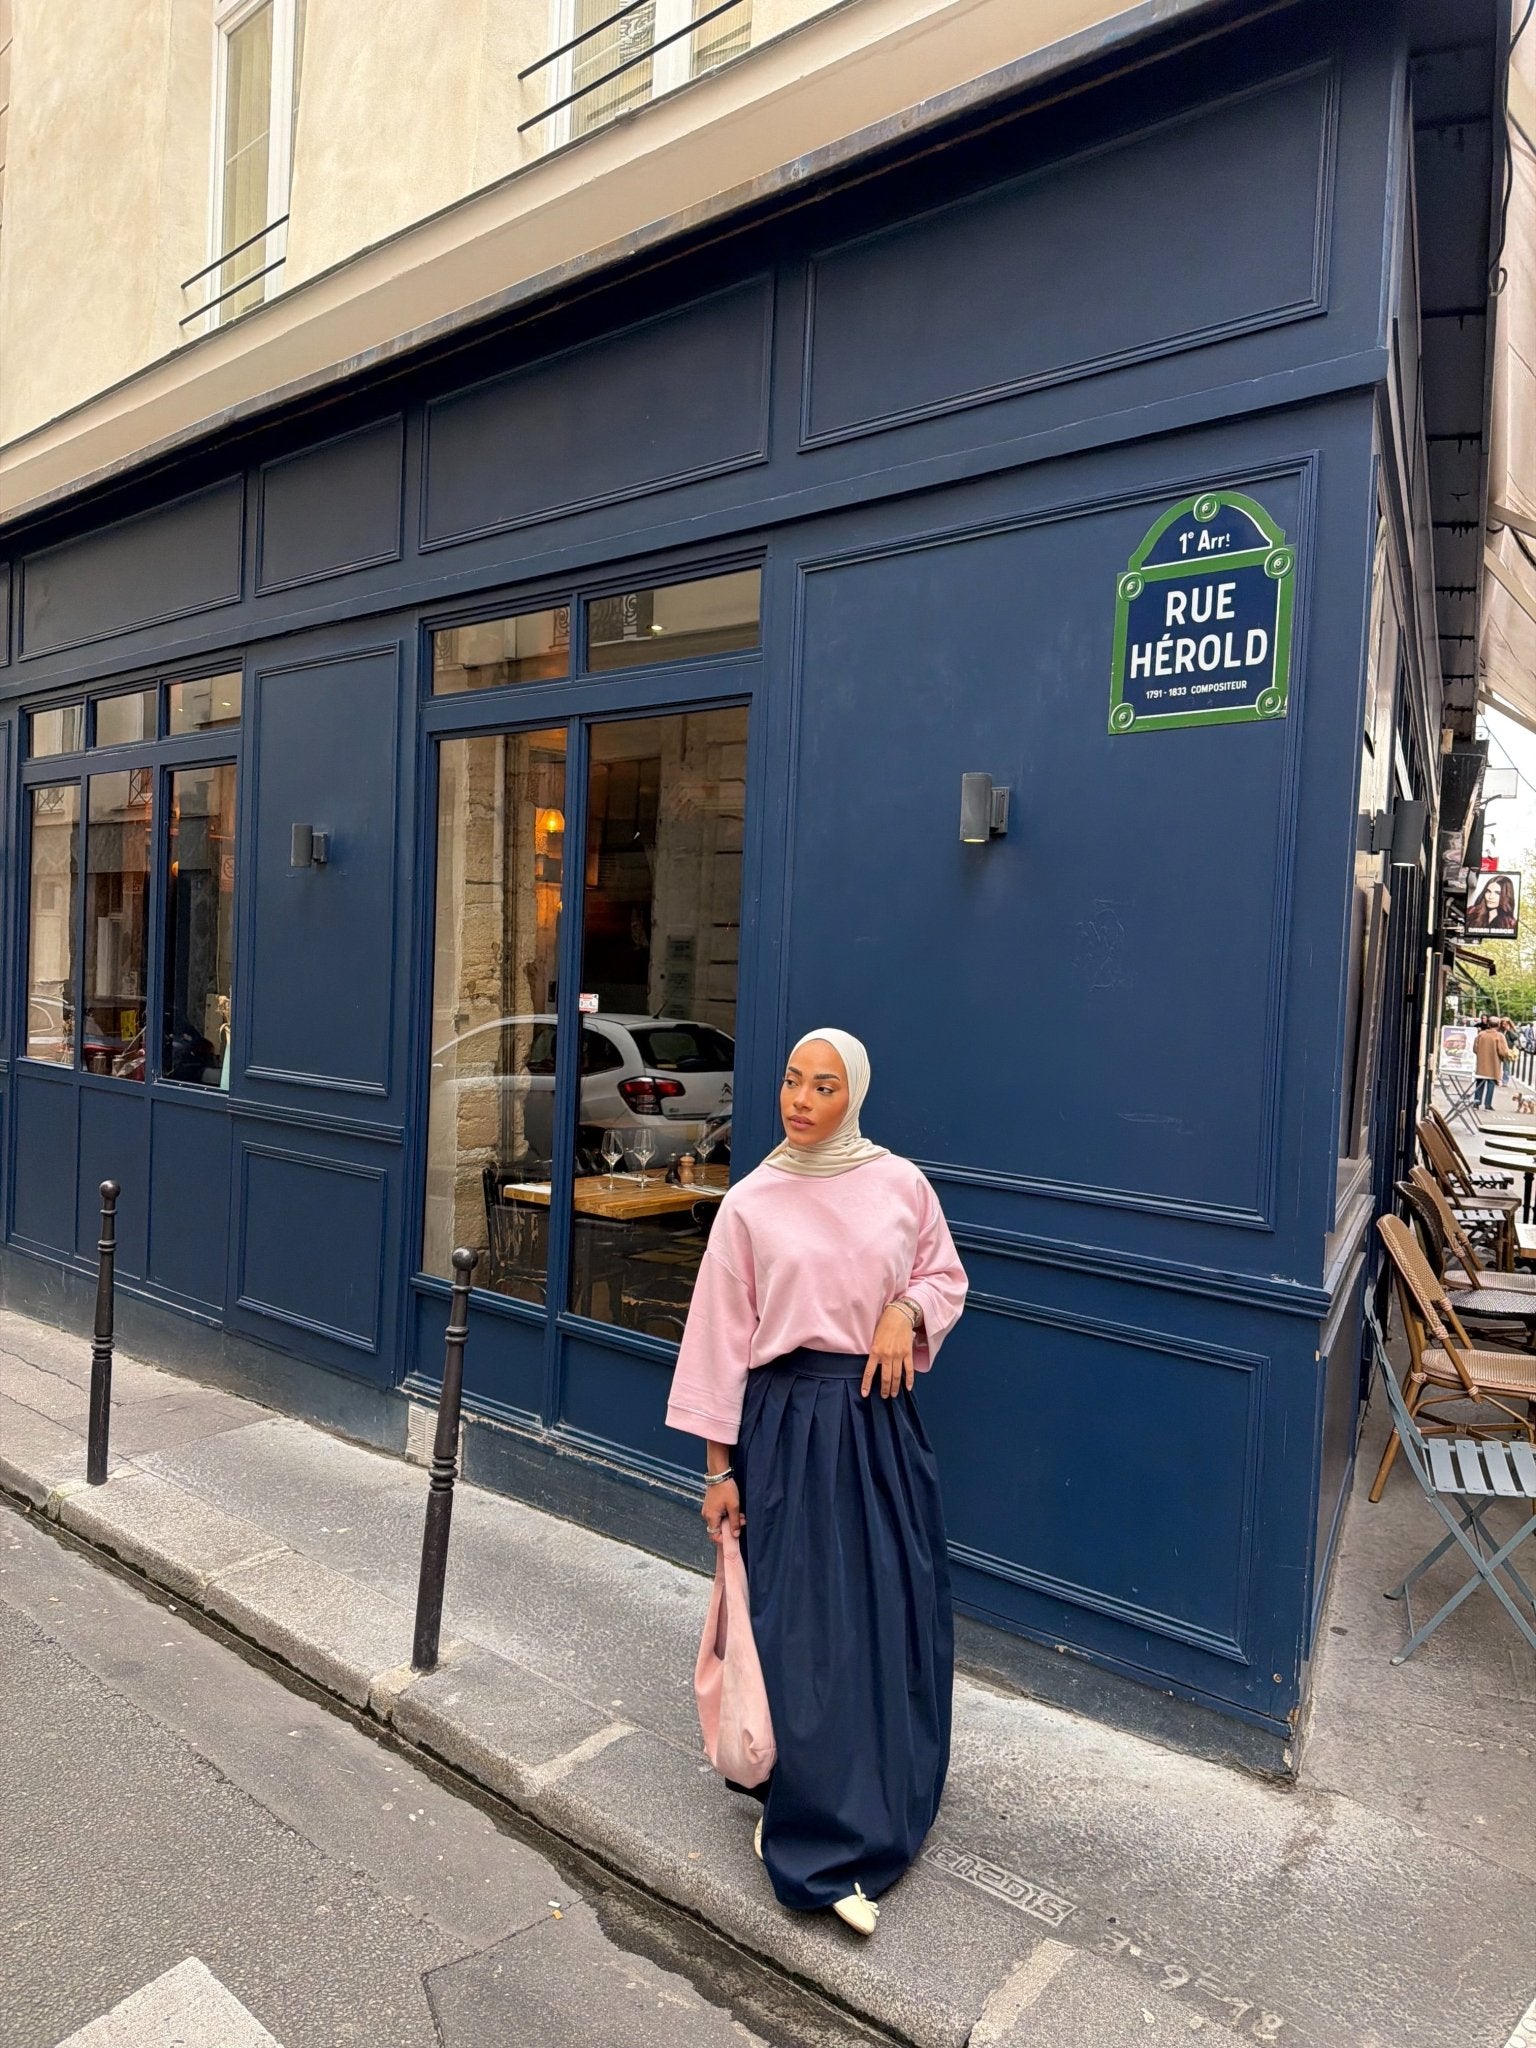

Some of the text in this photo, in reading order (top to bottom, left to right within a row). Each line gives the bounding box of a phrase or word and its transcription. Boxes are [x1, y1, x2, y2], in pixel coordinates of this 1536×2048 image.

[1165, 582, 1236, 627] RUE
[1130, 628, 1268, 679] HÉROLD
[1190, 680, 1248, 695] COMPOSITEUR
